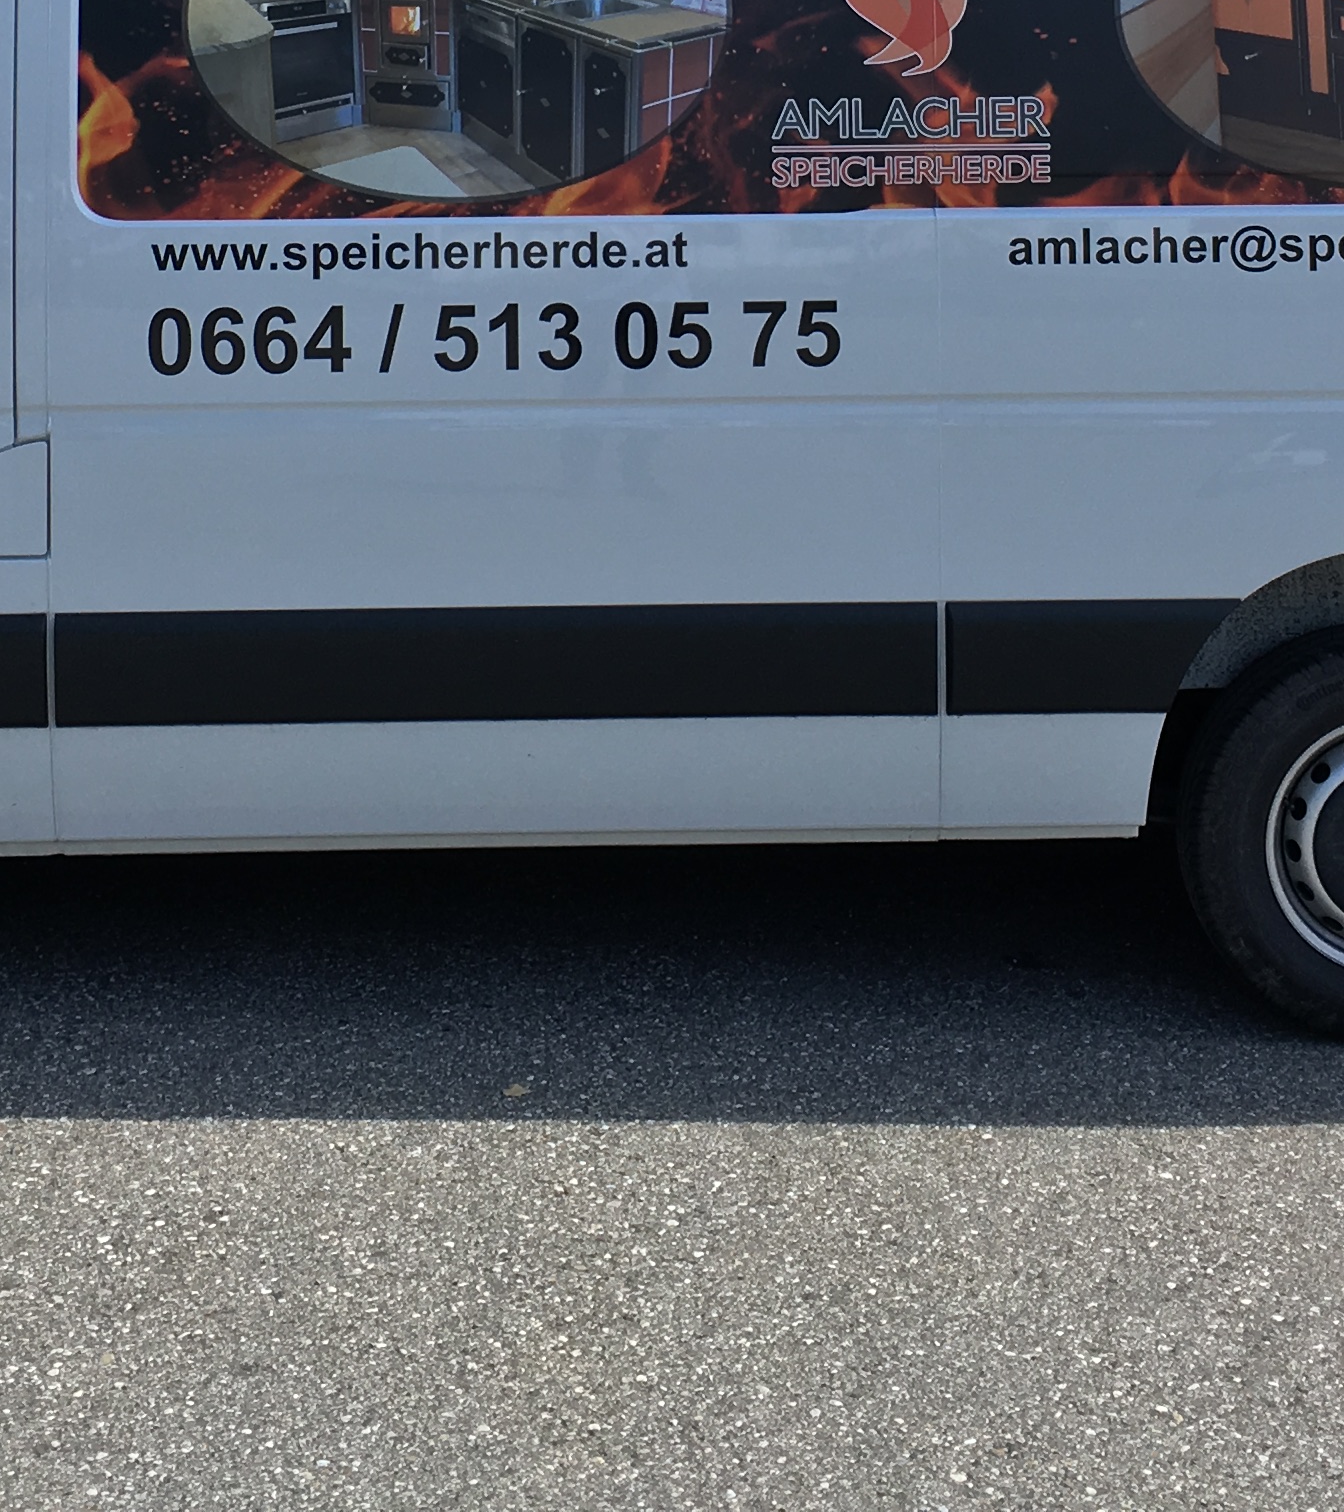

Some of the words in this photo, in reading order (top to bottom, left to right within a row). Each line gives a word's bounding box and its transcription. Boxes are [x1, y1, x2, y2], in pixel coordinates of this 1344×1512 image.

[771, 95, 1051, 140] AMLACHER
[771, 154, 1051, 188] SPEICHERHERDE
[150, 231, 688, 279] www.speicherherde.at
[147, 304, 352, 376] 0664
[434, 301, 583, 371] 513
[613, 300, 713, 369] 05
[741, 299, 842, 368] 75
